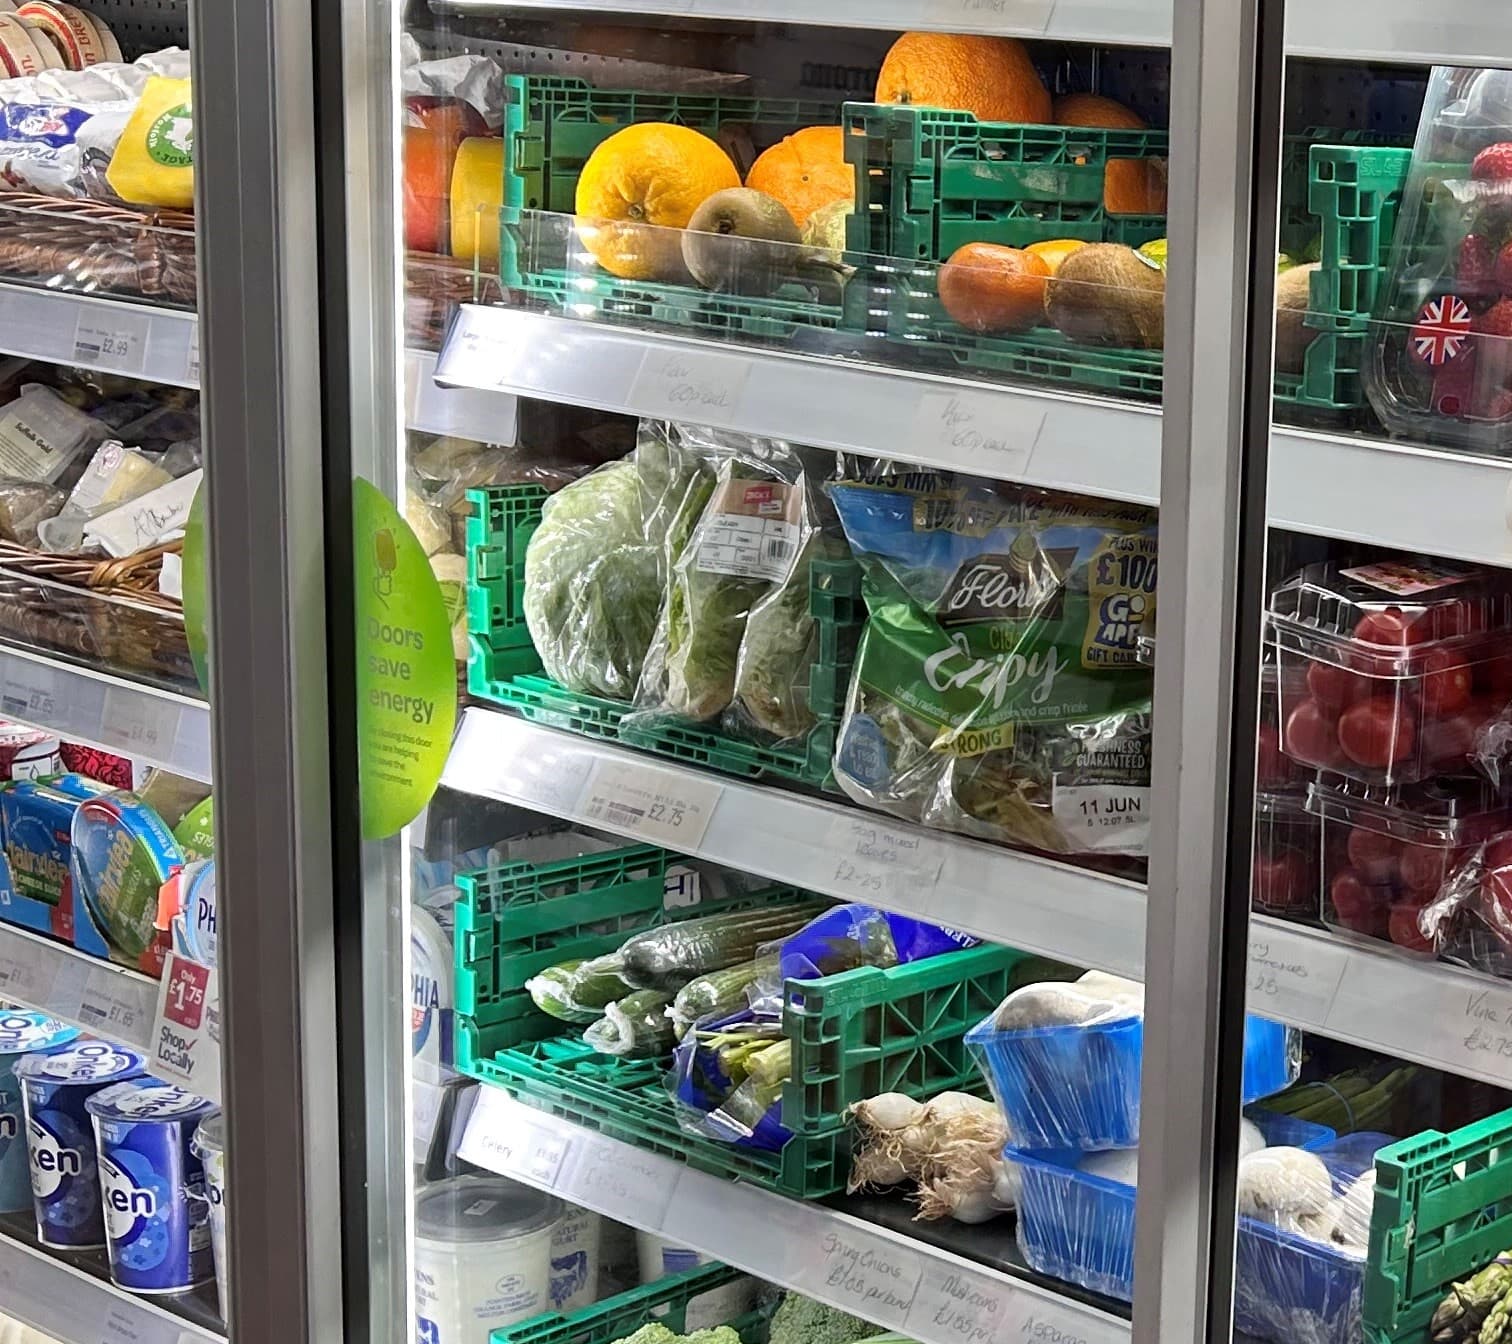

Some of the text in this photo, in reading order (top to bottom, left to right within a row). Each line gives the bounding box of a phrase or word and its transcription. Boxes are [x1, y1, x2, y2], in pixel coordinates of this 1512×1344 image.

[369, 617, 424, 650] Doors
[368, 655, 411, 680] save
[370, 687, 434, 724] energy
[1076, 754, 1146, 770] GUARANTEED
[648, 803, 685, 827] £2.75
[1080, 797, 1141, 815] 11 JUN
[180, 969, 196, 988] Only
[169, 977, 202, 1012] £1.75
[1466, 990, 1497, 1022] Vine
[160, 1025, 186, 1052] Shop
[158, 1041, 195, 1074] Locally
